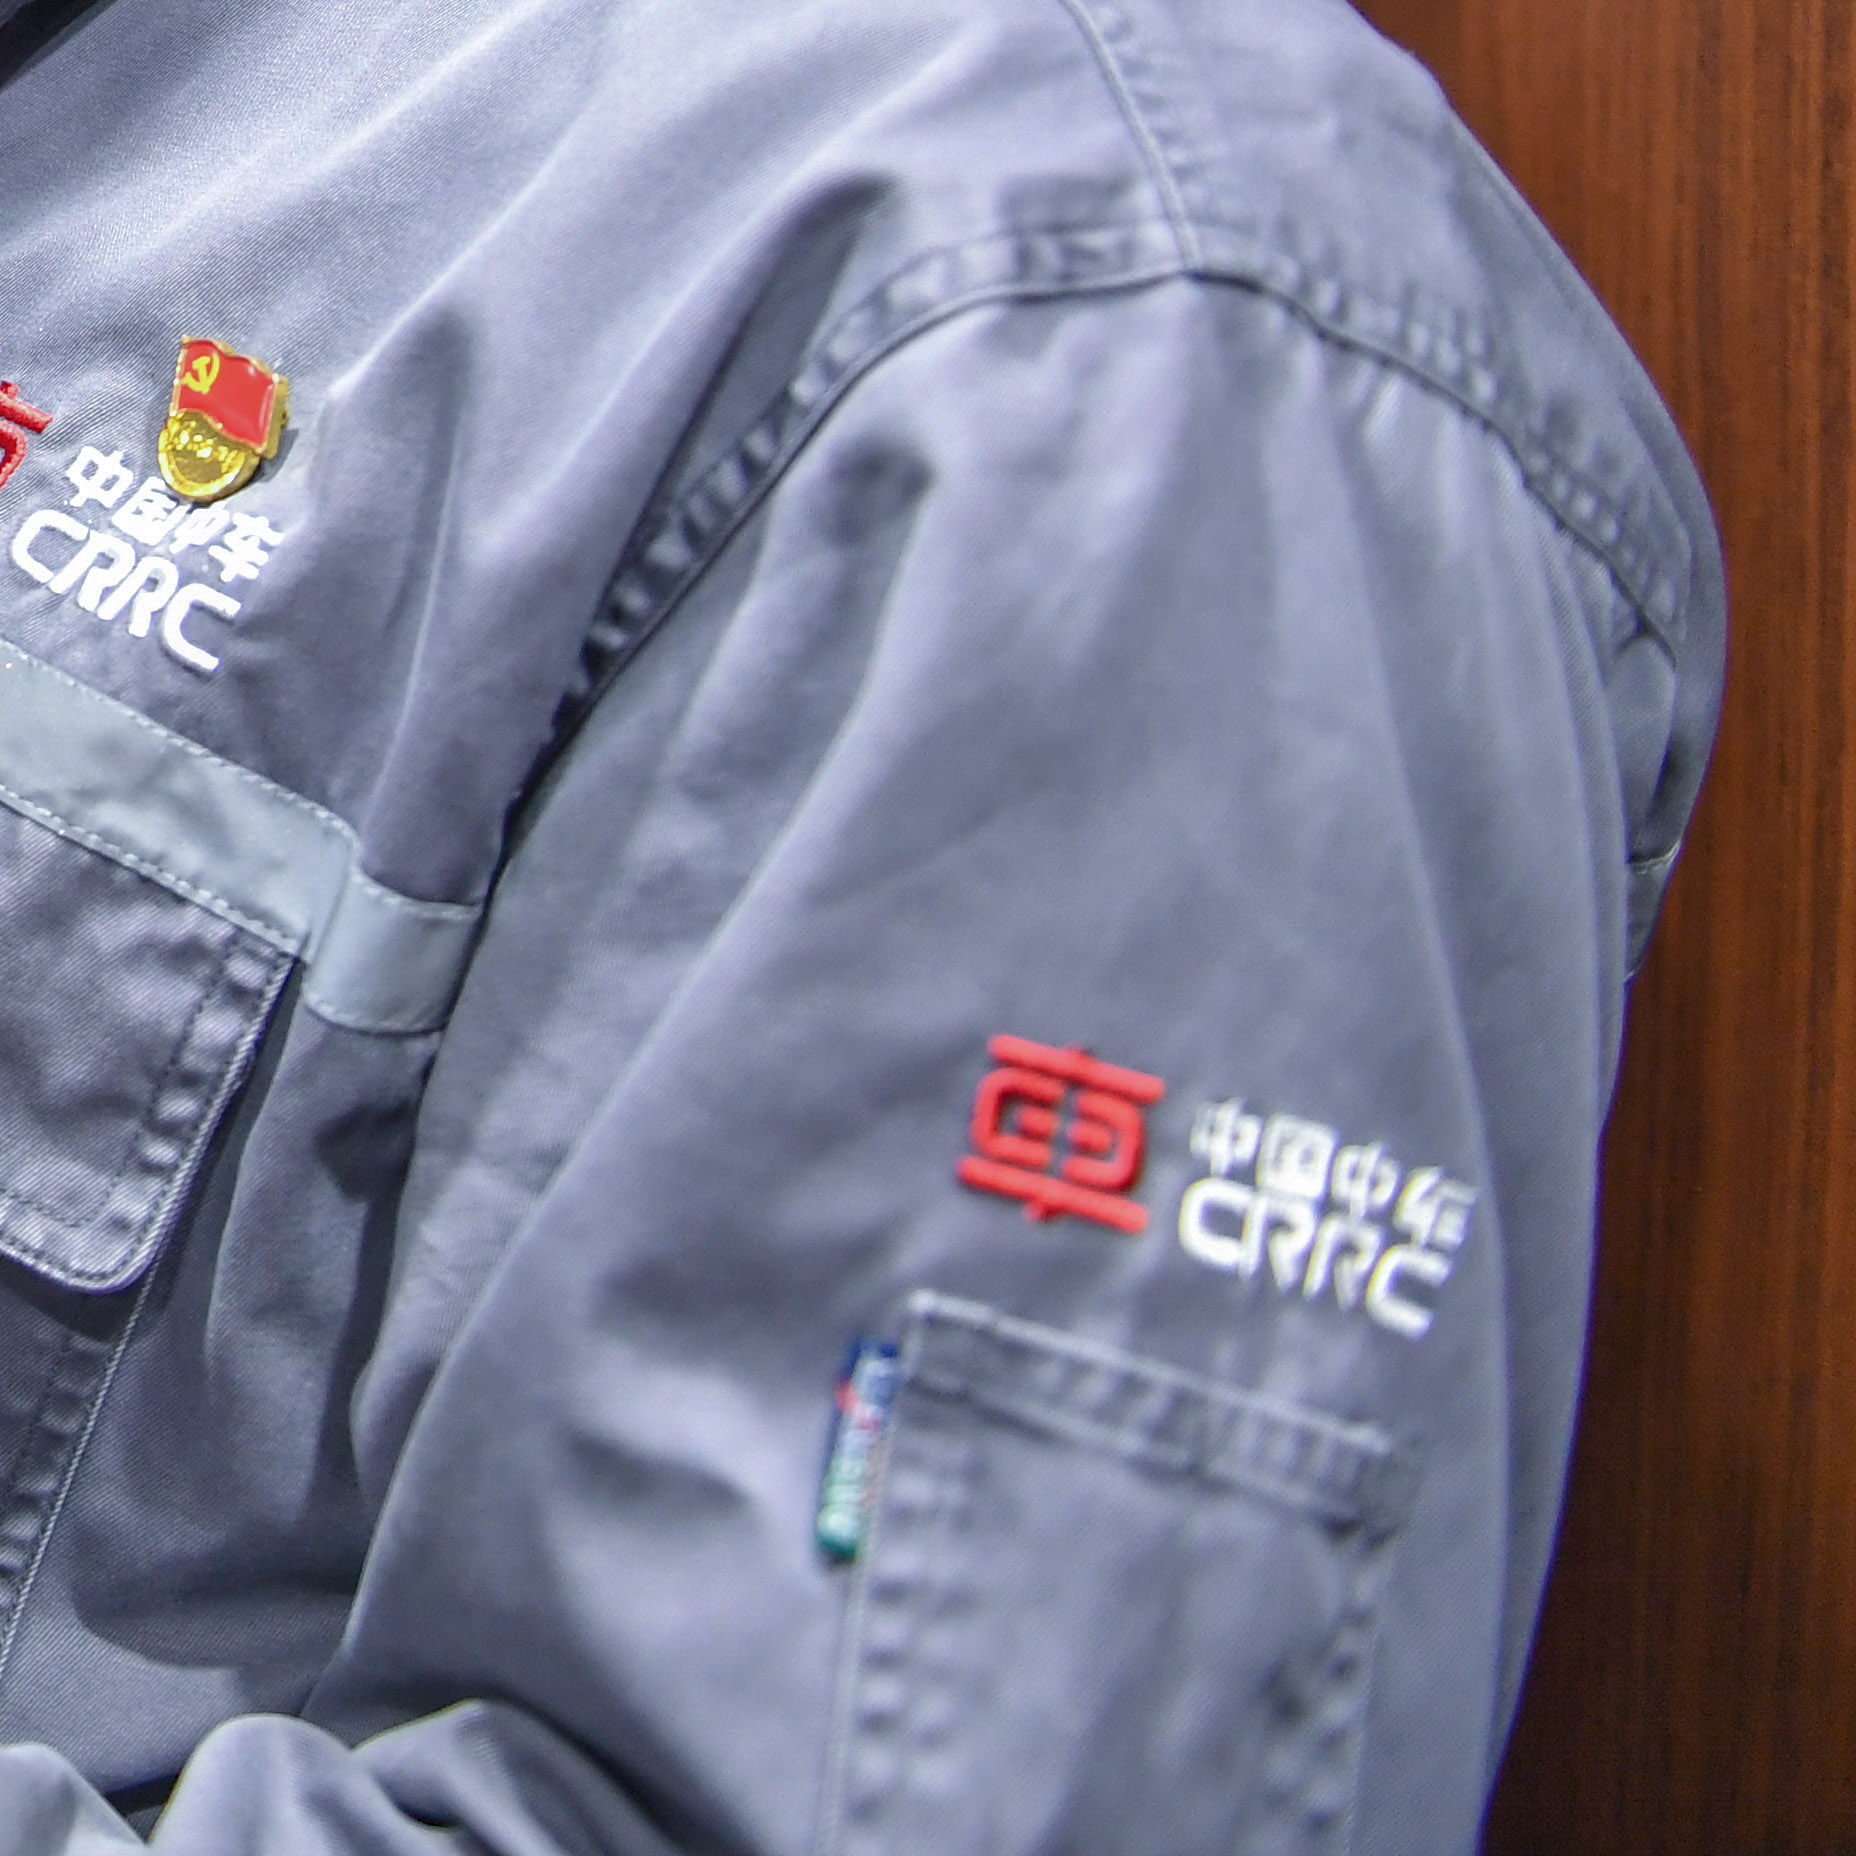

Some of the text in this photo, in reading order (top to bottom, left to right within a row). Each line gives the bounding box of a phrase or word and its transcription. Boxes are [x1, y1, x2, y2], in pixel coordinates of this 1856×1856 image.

[10, 508, 243, 673] CRRC
[64, 445, 284, 584] 中国中车
[1191, 1099, 1479, 1251] 中国中车
[1178, 1177, 1452, 1342] CRRC
